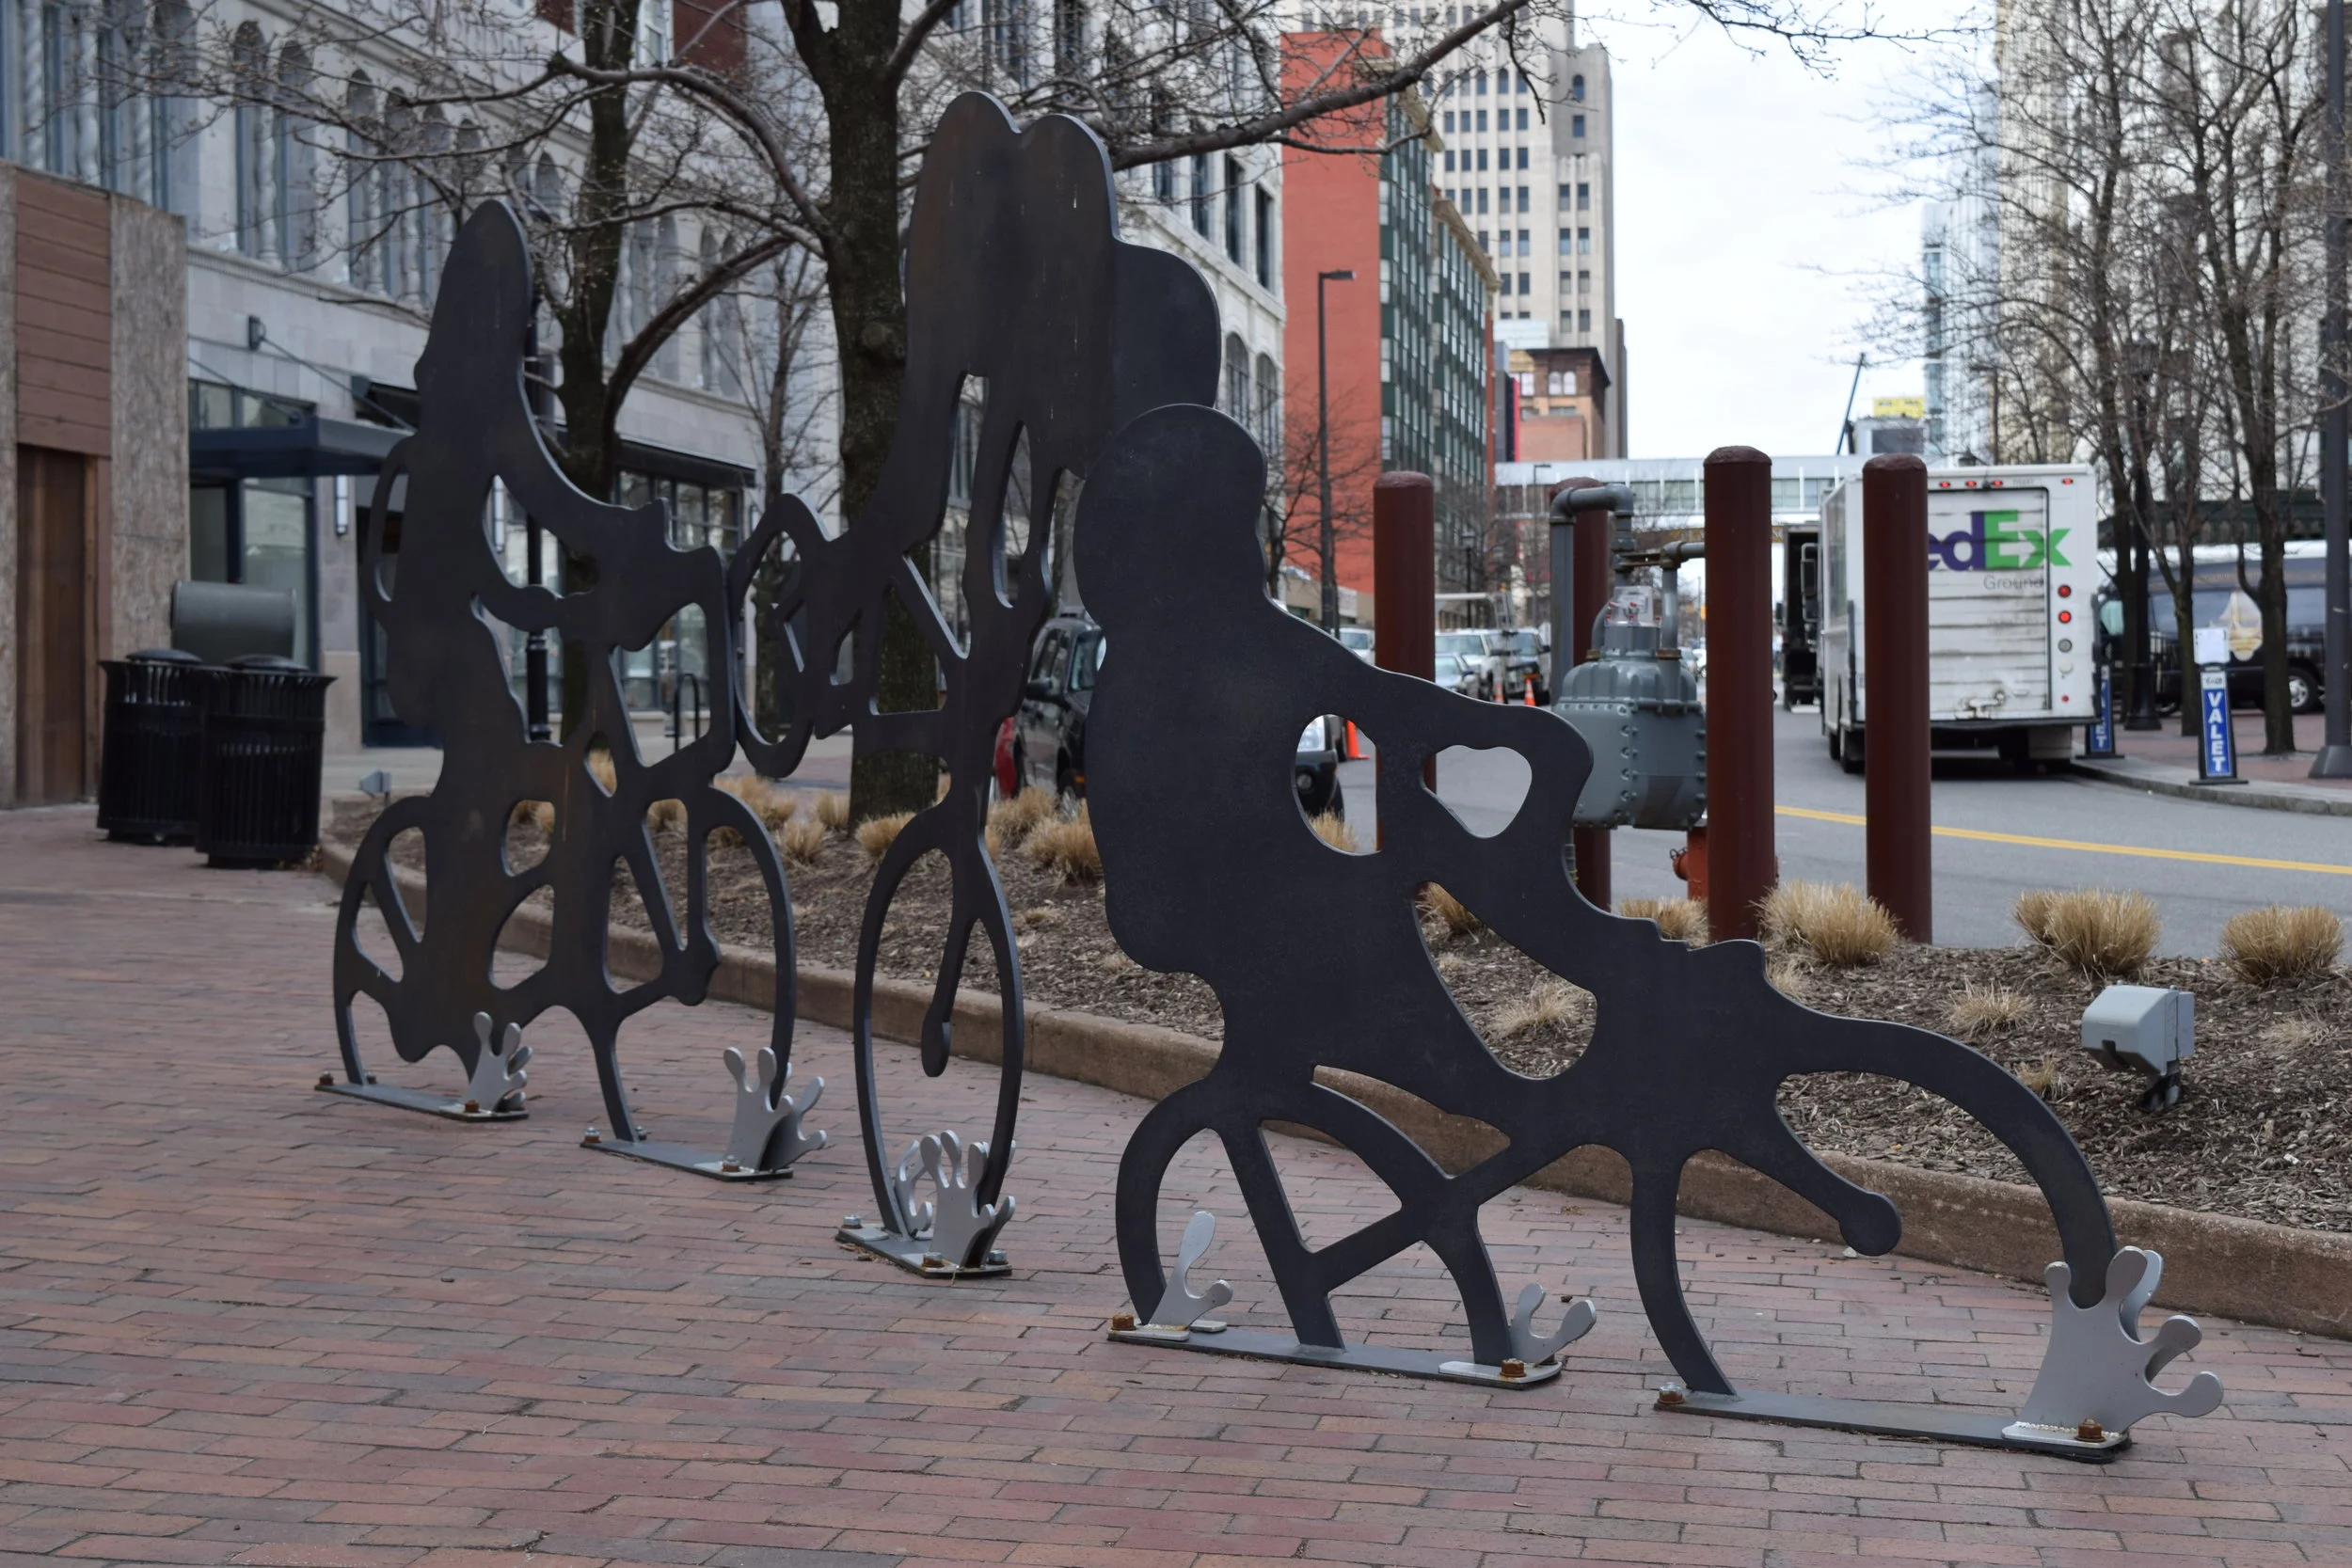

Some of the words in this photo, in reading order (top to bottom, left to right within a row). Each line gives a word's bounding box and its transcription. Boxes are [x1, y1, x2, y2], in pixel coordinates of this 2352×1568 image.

[1927, 509, 2073, 571] dEx
[1983, 574, 2044, 591] Ground
[2207, 691, 2226, 772] VALET
